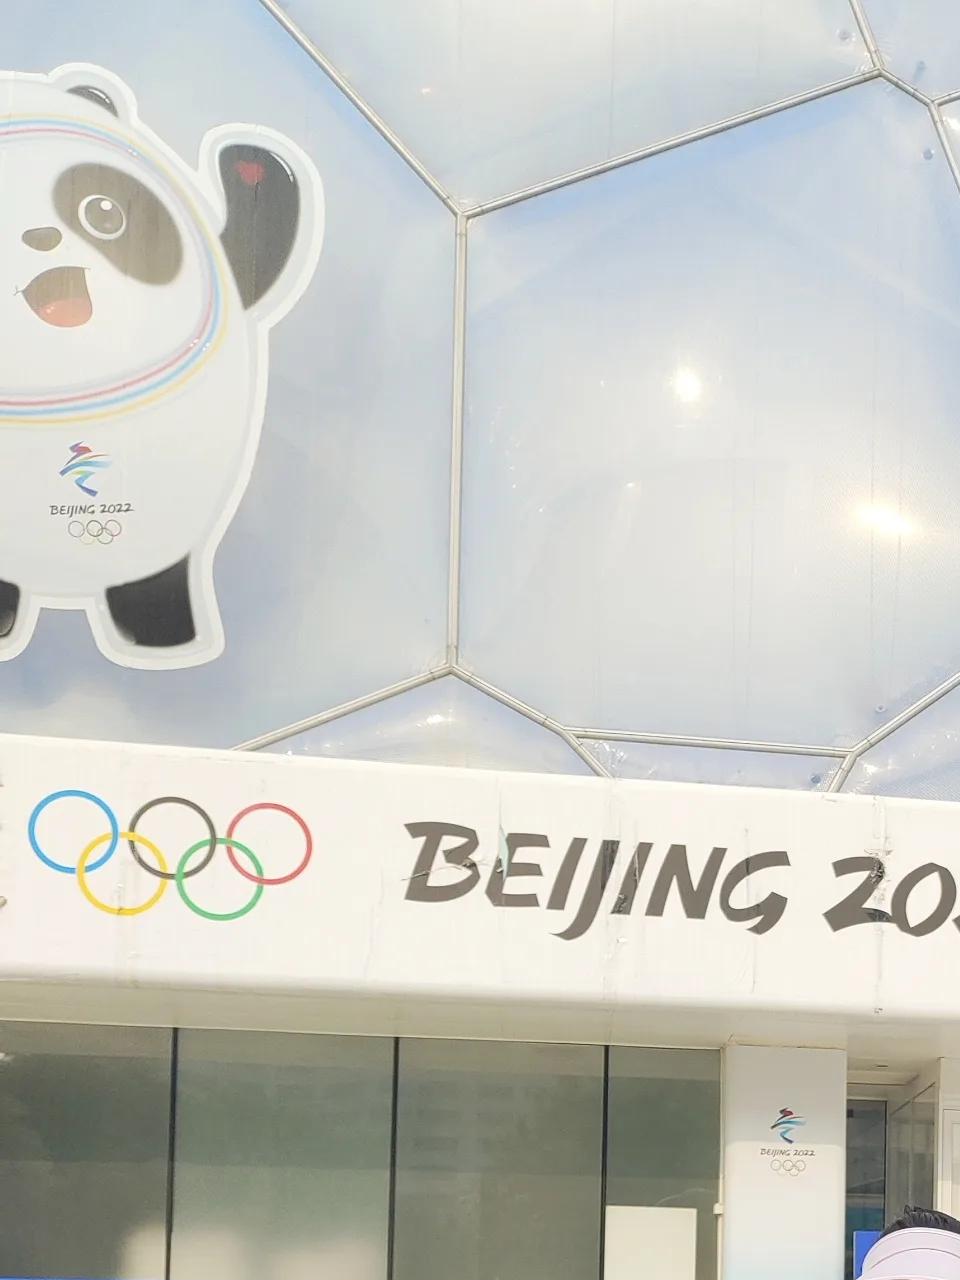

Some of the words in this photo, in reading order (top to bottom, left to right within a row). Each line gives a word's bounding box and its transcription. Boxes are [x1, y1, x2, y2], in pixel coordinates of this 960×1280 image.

[50, 504, 96, 518] BEIJING
[100, 503, 135, 515] 2022
[403, 821, 792, 941] BEIJING
[760, 1148, 790, 1157] BEIJING
